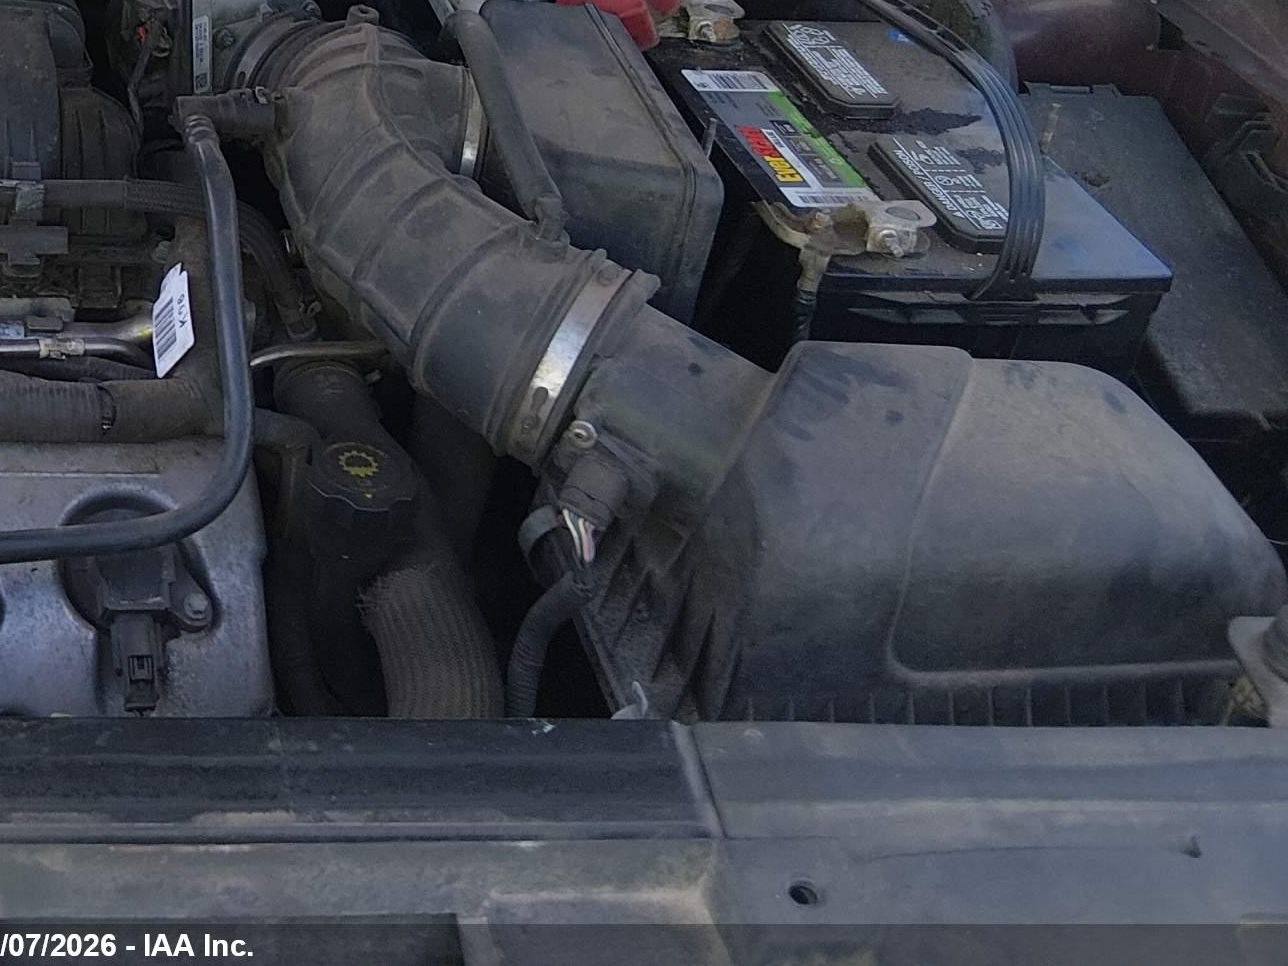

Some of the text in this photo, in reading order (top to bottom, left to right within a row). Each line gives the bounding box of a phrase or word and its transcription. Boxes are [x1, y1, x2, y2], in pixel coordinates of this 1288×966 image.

[737, 124, 804, 182] EverStart
[893, 149, 924, 177] POISON
[923, 181, 958, 211] DANGER
